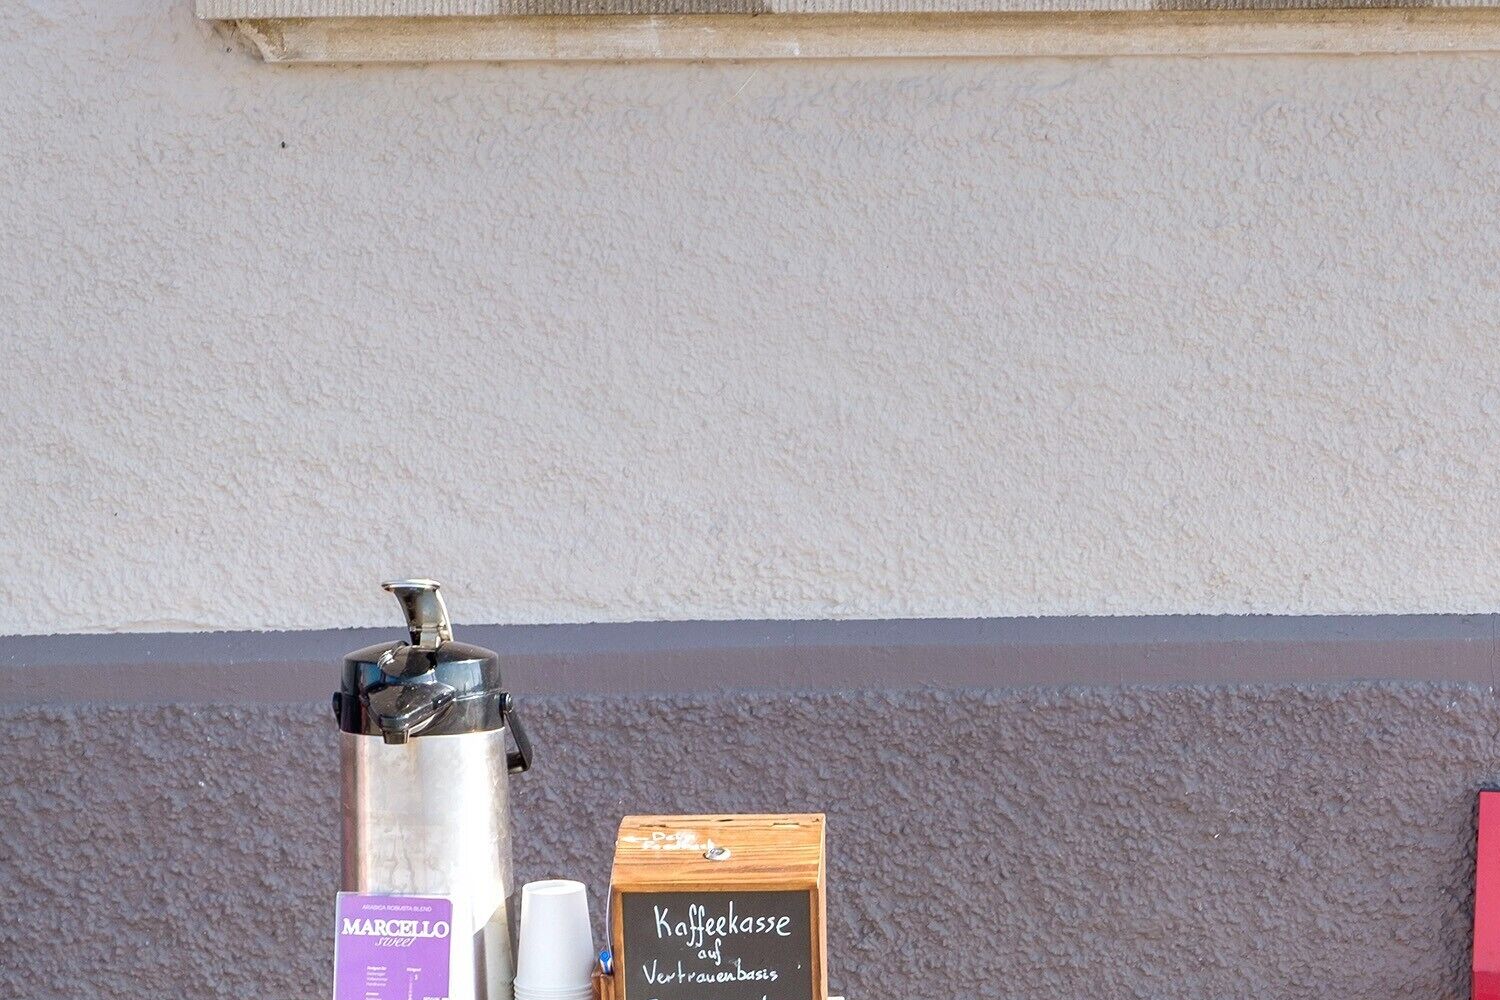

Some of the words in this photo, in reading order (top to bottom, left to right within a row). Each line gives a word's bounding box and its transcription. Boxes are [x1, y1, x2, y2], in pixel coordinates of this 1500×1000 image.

[341, 917, 450, 939] MARCELLO
[653, 900, 791, 948] Kaffeekasse
[374, 936, 417, 948] sweet
[697, 937, 722, 966] auf
